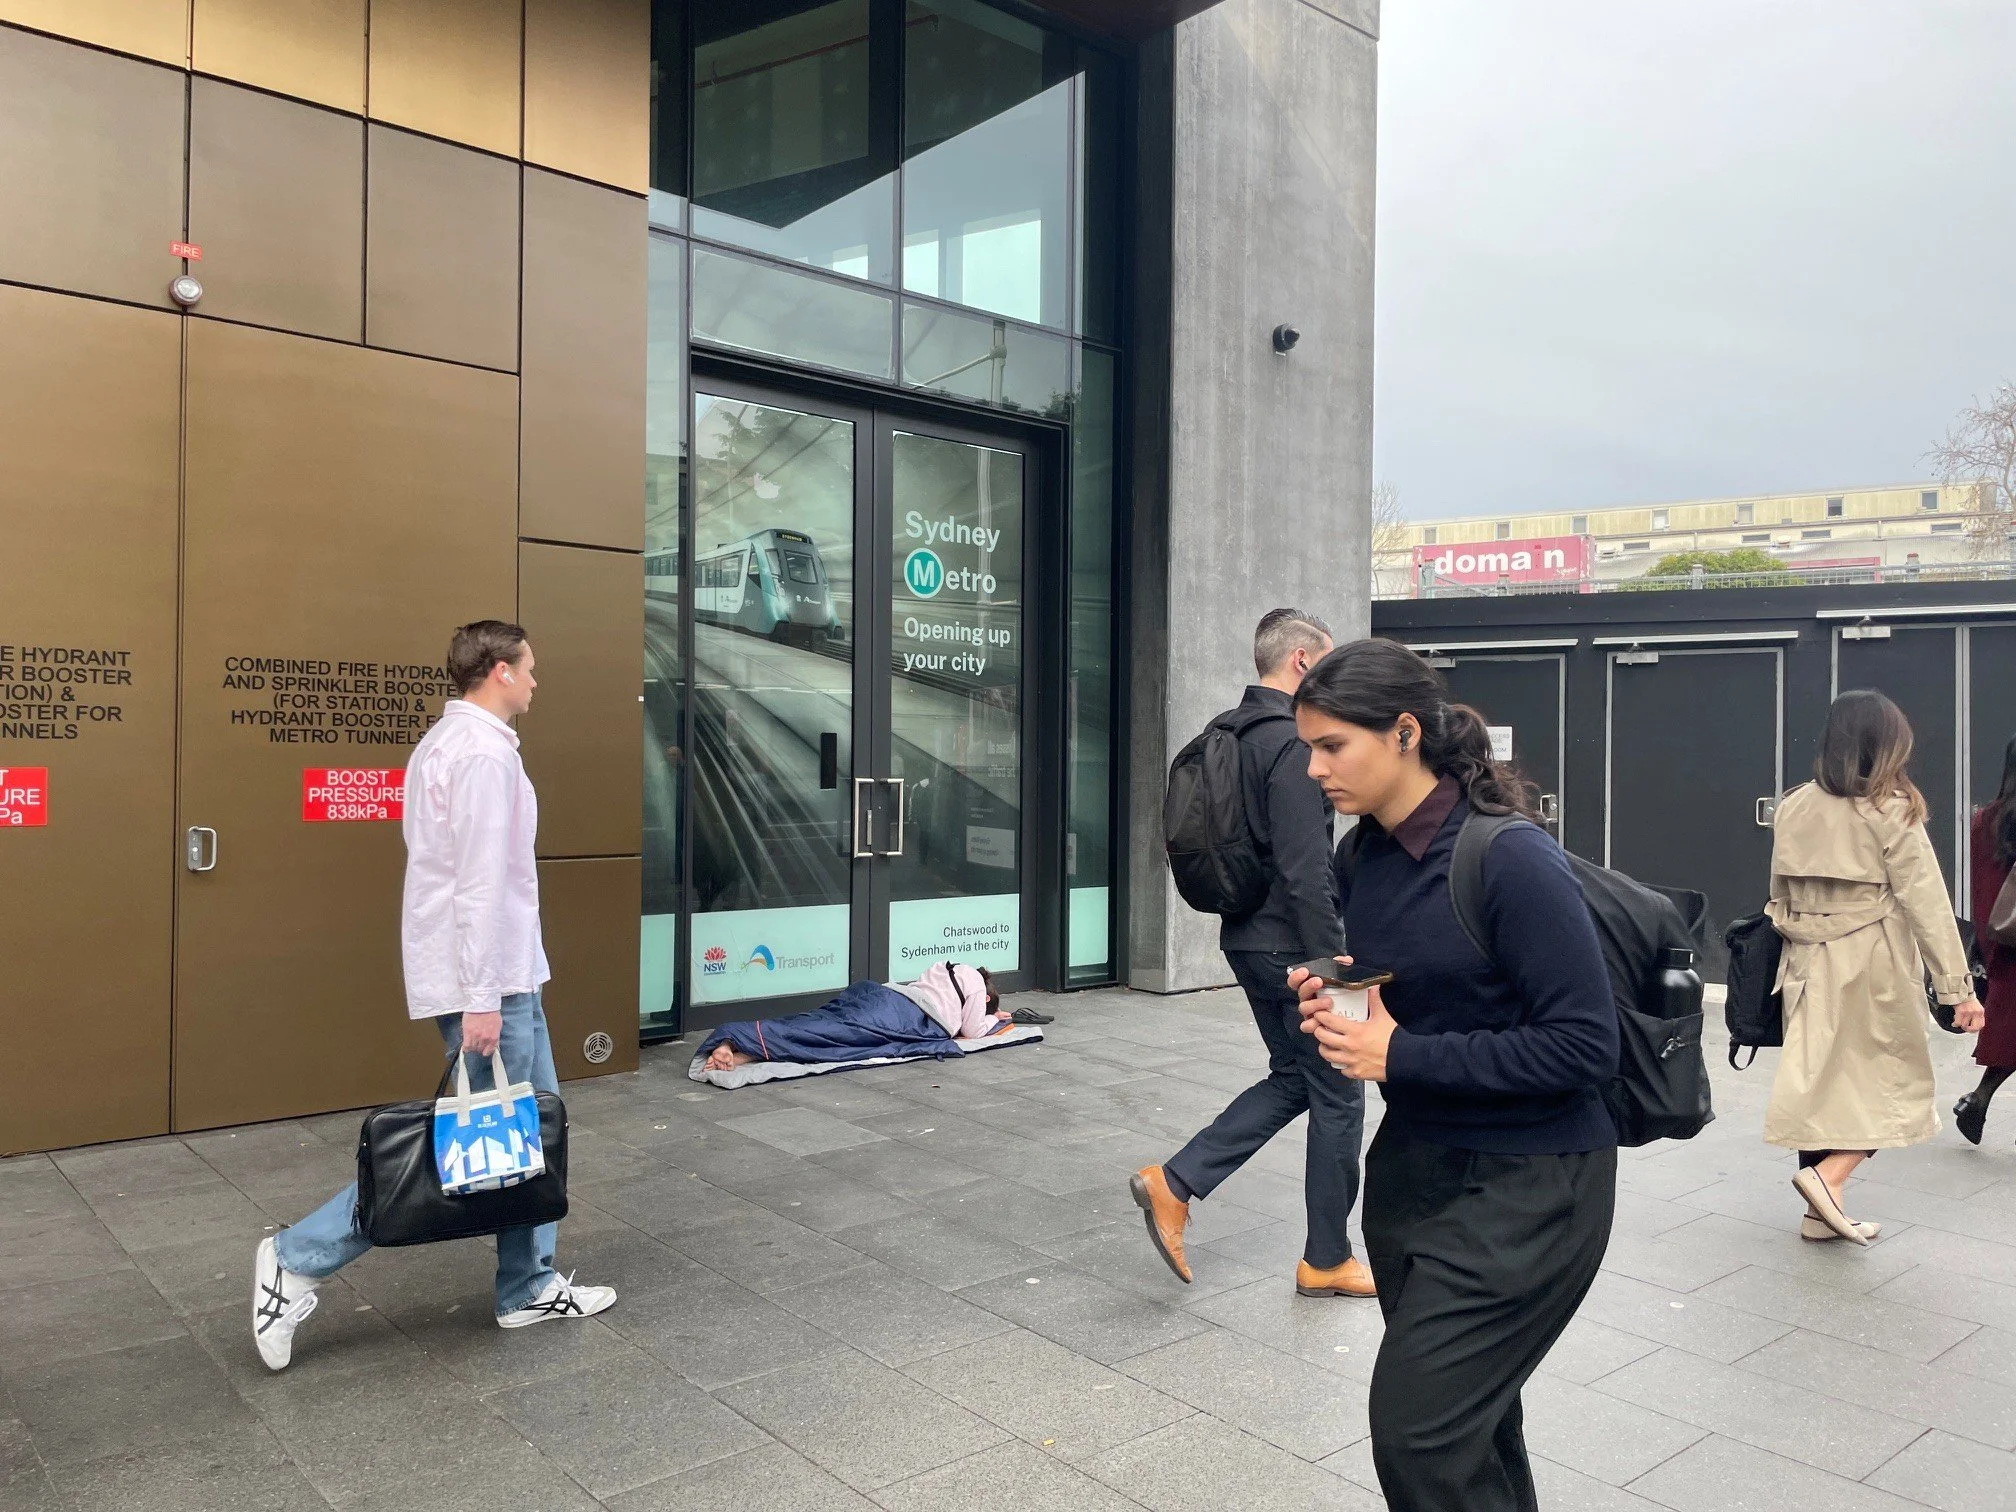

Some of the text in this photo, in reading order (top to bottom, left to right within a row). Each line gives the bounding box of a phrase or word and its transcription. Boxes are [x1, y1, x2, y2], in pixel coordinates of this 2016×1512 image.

[173, 244, 200, 258] FIRE
[905, 510, 1000, 553] Sydney
[912, 557, 997, 594] Metro
[904, 617, 1011, 648] Opening up
[22, 646, 131, 667] HYDRANT
[903, 651, 986, 676] your city
[22, 665, 132, 686] BOOSTER
[225, 657, 331, 675] COMBINED
[338, 662, 378, 677] FIRE
[60, 686, 75, 701] &
[222, 674, 458, 697] AND SPRINKLER BOOSTE
[273, 692, 426, 713] (FOR STATION) &
[76, 705, 123, 722] FOR
[231, 709, 326, 726] HYDRANT
[332, 713, 420, 728] BOOSTER
[269, 728, 338, 743] METRO
[327, 770, 389, 786] BOOST
[308, 787, 405, 803] PRESSURE
[327, 804, 388, 819] 838kPa
[943, 923, 1010, 938] Chatswood to
[901, 938, 1010, 960] Sydenham via the city
[703, 962, 727, 972] NSW
[776, 952, 836, 969] Transport
